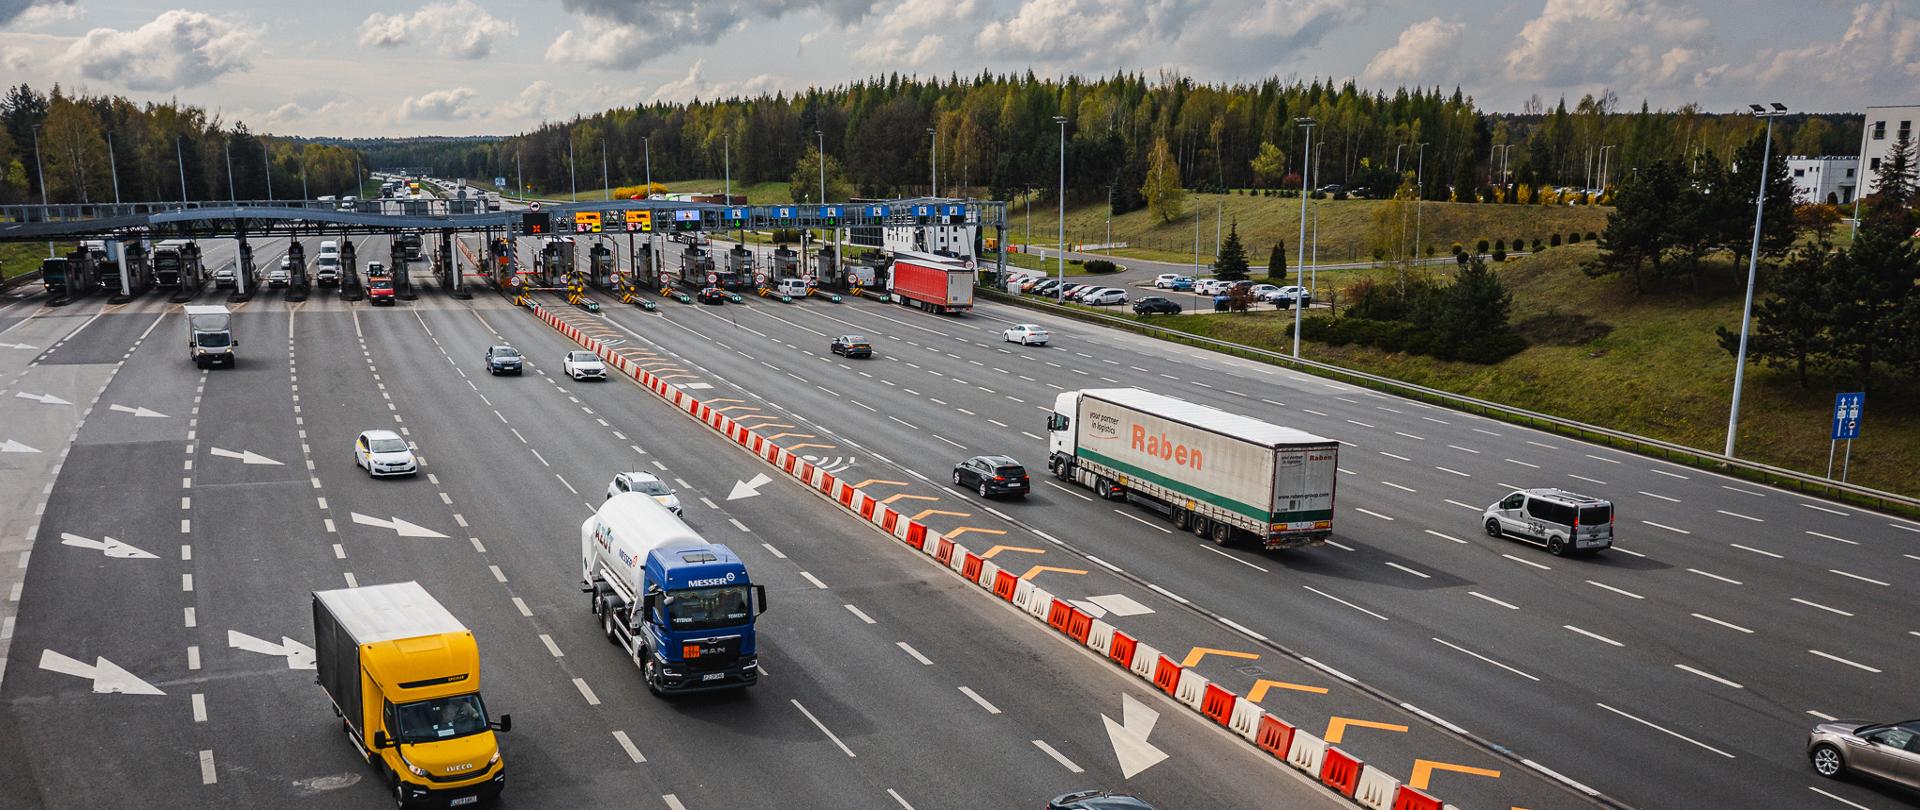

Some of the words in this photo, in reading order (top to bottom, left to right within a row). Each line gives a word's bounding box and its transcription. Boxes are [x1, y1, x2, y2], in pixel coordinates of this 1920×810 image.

[1089, 412, 1101, 420] your
[1101, 415, 1119, 425] partner
[1091, 420, 1097, 429] in
[1097, 422, 1115, 435] logistics
[1131, 423, 1203, 471] Raben
[619, 548, 632, 568] MESSER
[688, 577, 727, 588] MESSER
[700, 647, 726, 655] MAN
[446, 763, 473, 772] IVECO
